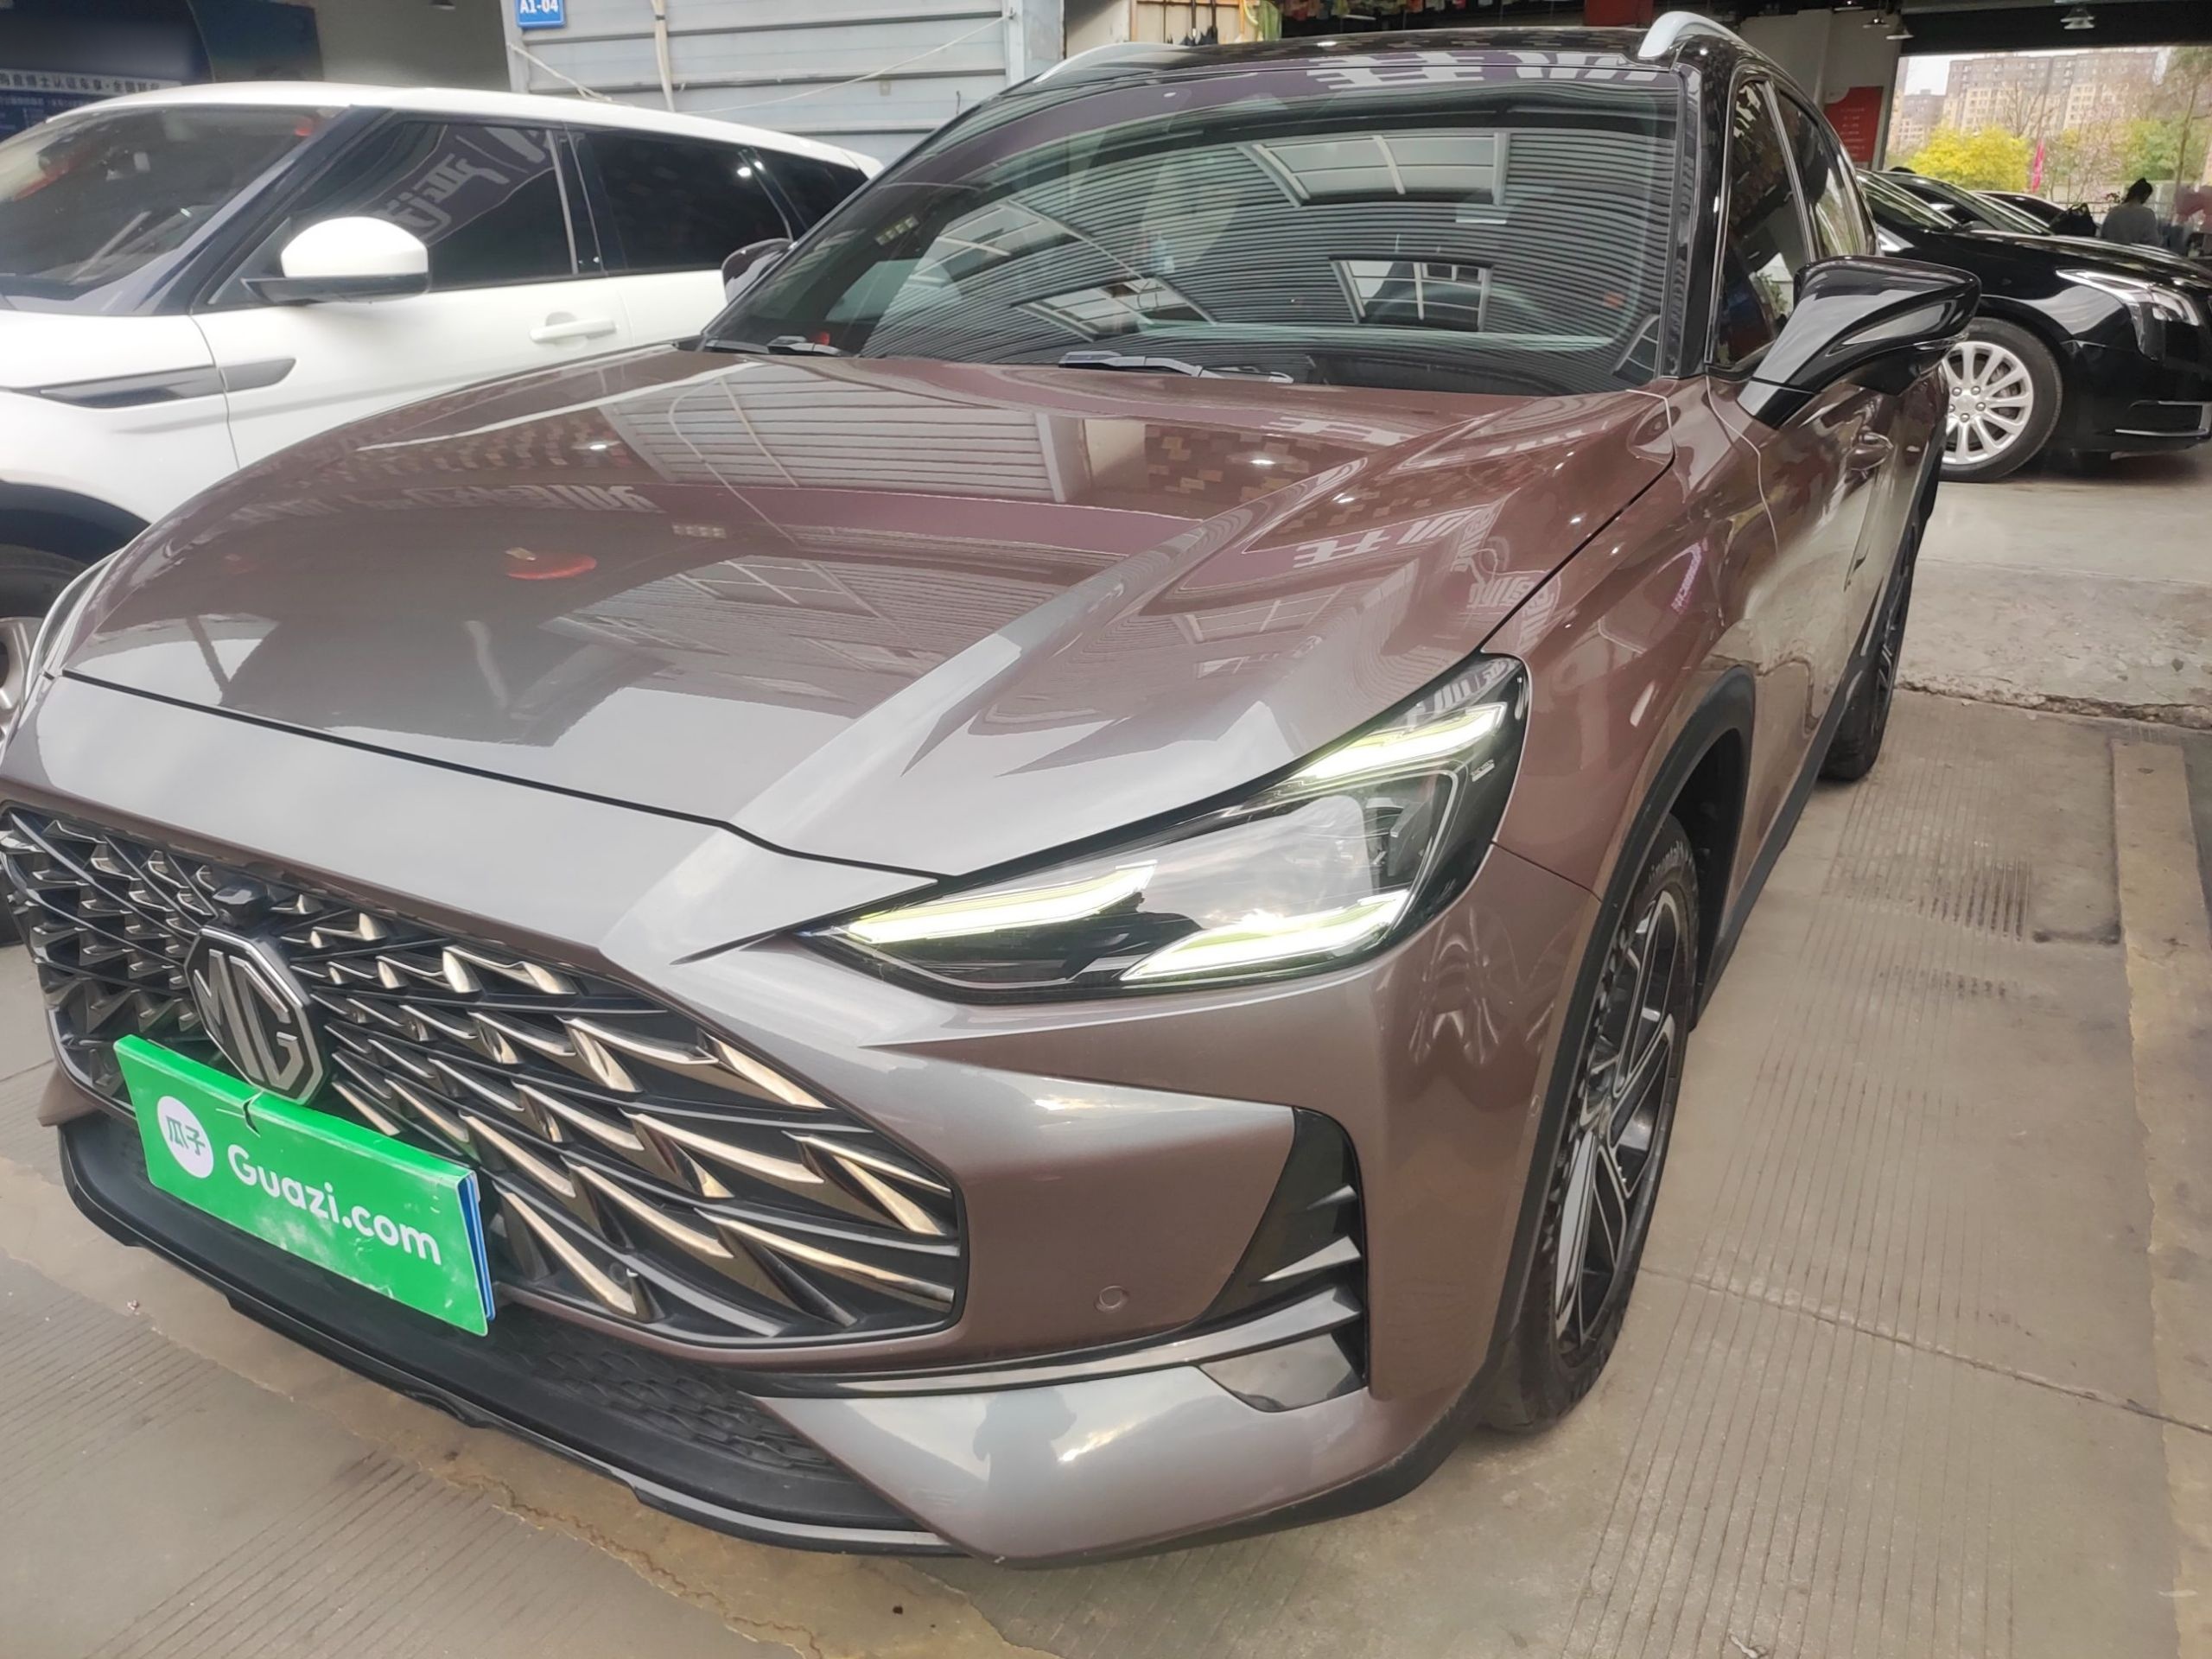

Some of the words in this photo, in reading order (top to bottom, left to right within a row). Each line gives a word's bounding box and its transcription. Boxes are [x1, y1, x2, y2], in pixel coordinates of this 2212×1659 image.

[519, 0, 559, 14] A1-04
[193, 948, 304, 1091] MG
[165, 1114, 207, 1156] 瓜子
[227, 1143, 442, 1266] Guazi.com
